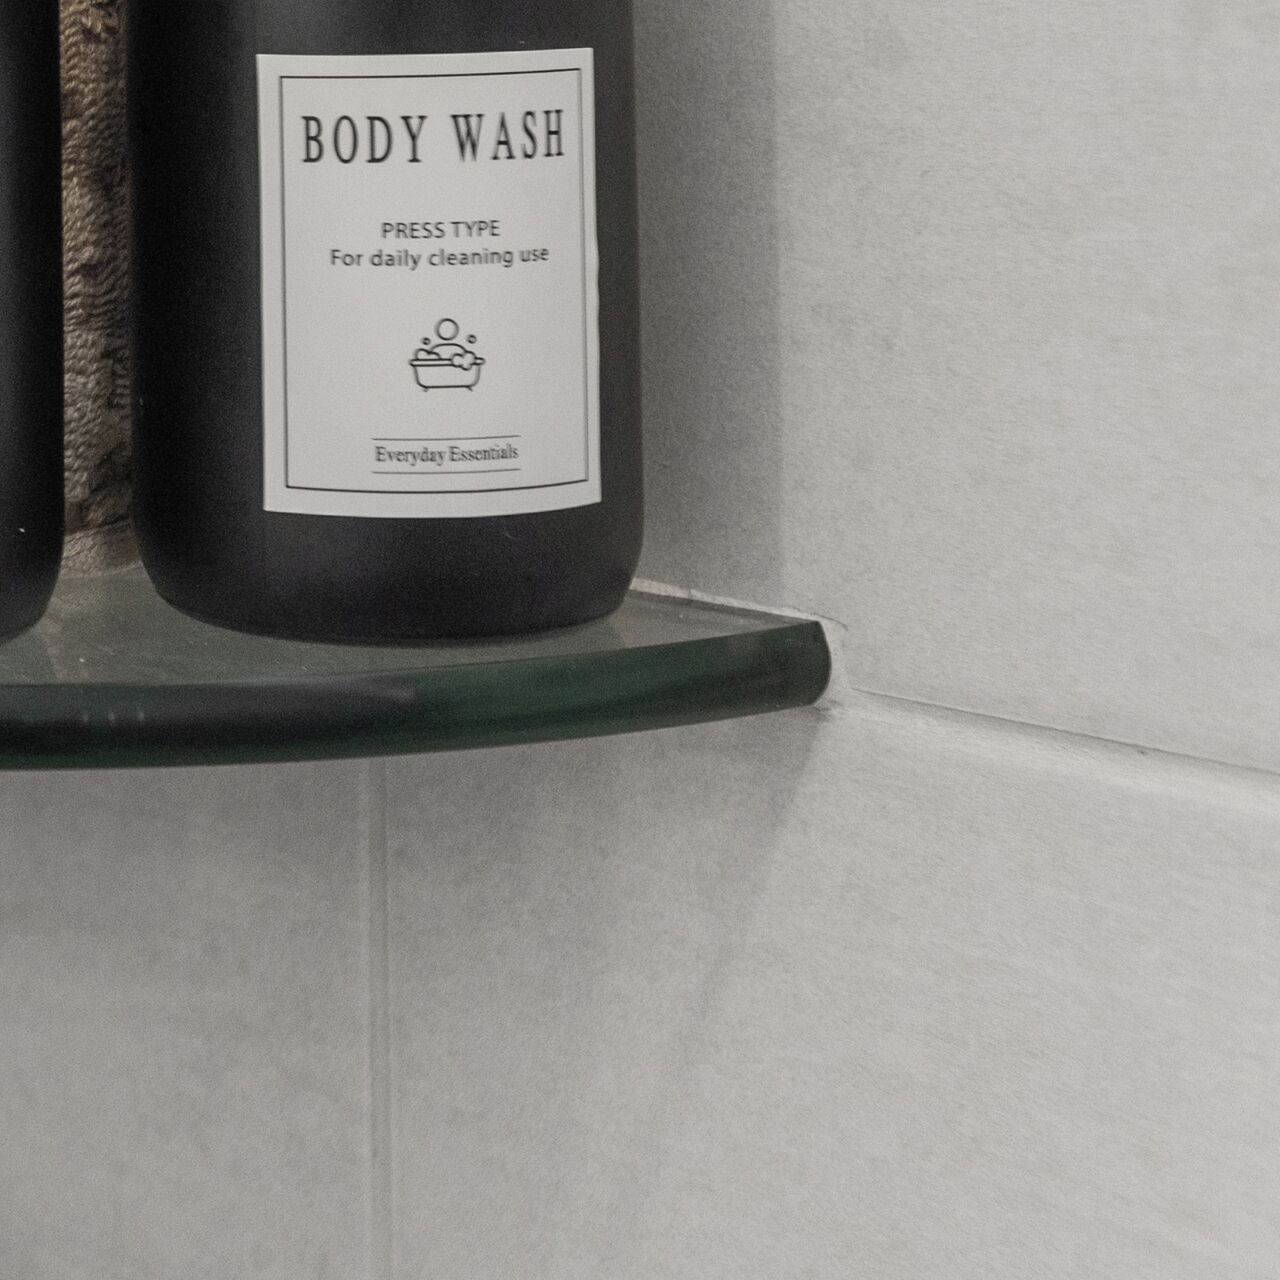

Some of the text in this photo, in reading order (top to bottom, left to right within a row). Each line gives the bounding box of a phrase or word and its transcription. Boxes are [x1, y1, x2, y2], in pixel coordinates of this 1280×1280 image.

[301, 108, 565, 165] BODY WASH
[382, 219, 500, 239] PRESS TYPE
[330, 248, 549, 271] For daily cleaning use
[375, 443, 519, 467] Everyday Essentials
